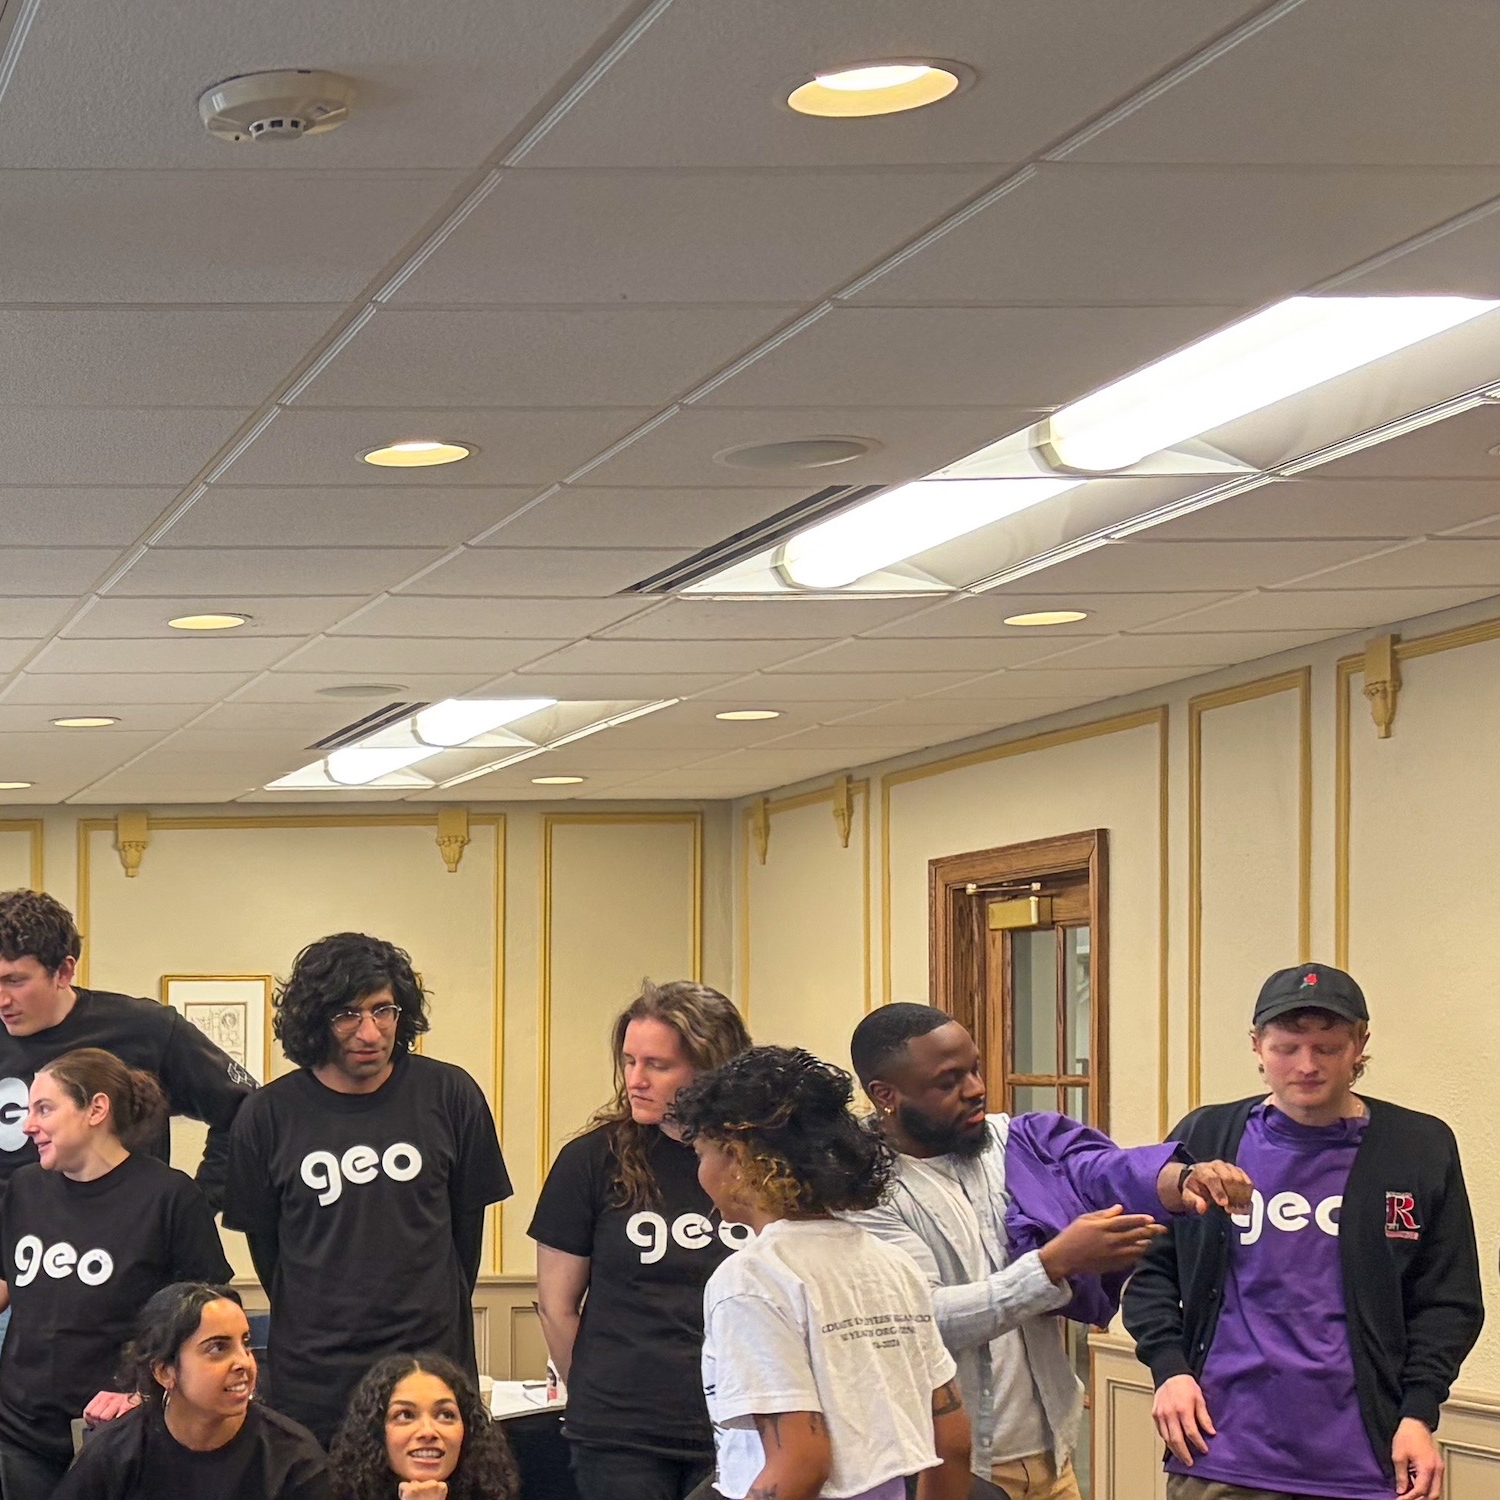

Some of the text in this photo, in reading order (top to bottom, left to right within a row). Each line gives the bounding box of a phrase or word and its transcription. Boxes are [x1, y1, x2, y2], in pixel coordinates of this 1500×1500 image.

[301, 1143, 422, 1207] geo
[14, 1235, 114, 1287] geo
[626, 1211, 757, 1264] geo
